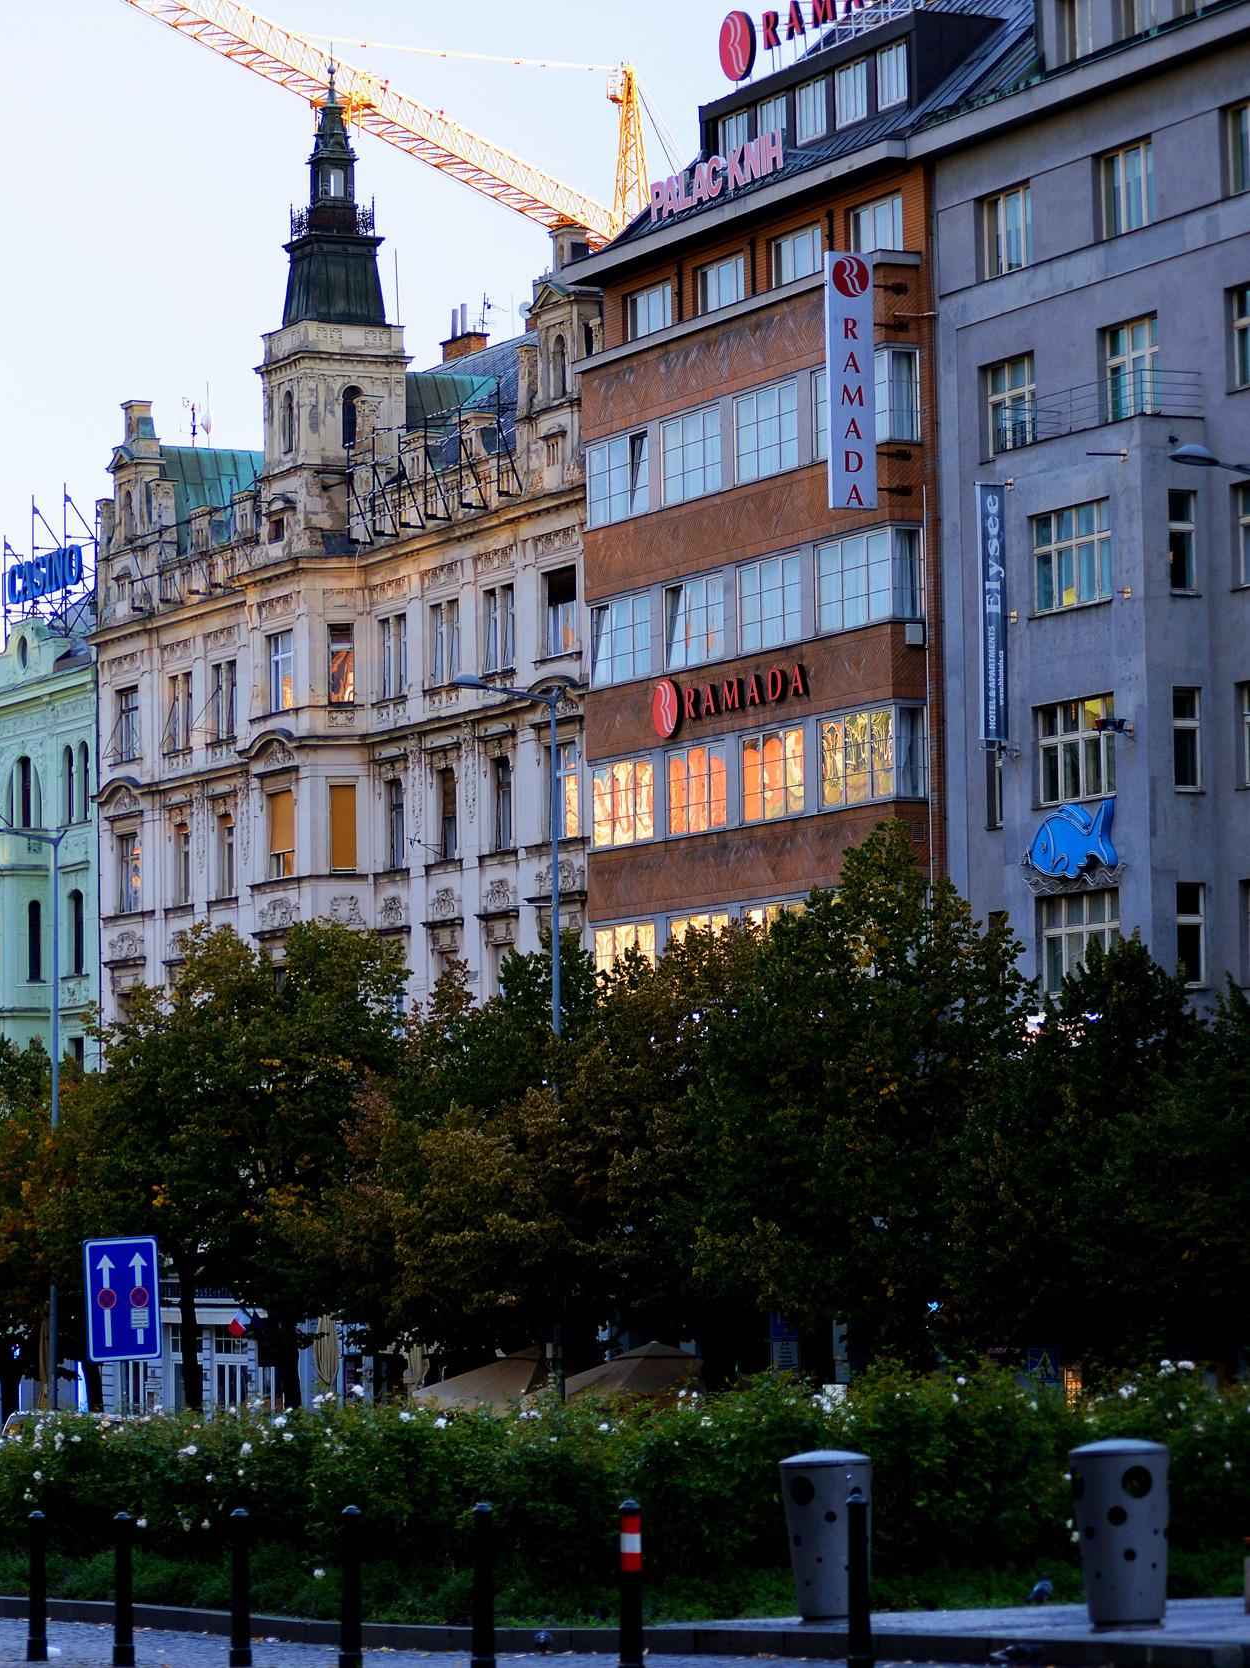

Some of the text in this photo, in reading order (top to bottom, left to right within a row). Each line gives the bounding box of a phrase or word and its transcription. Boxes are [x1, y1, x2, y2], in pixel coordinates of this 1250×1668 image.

[727, 128, 784, 190] KNIH
[841, 317, 864, 506] RAMADA
[7, 544, 83, 604] CASINO
[684, 663, 805, 719] RAMADA
